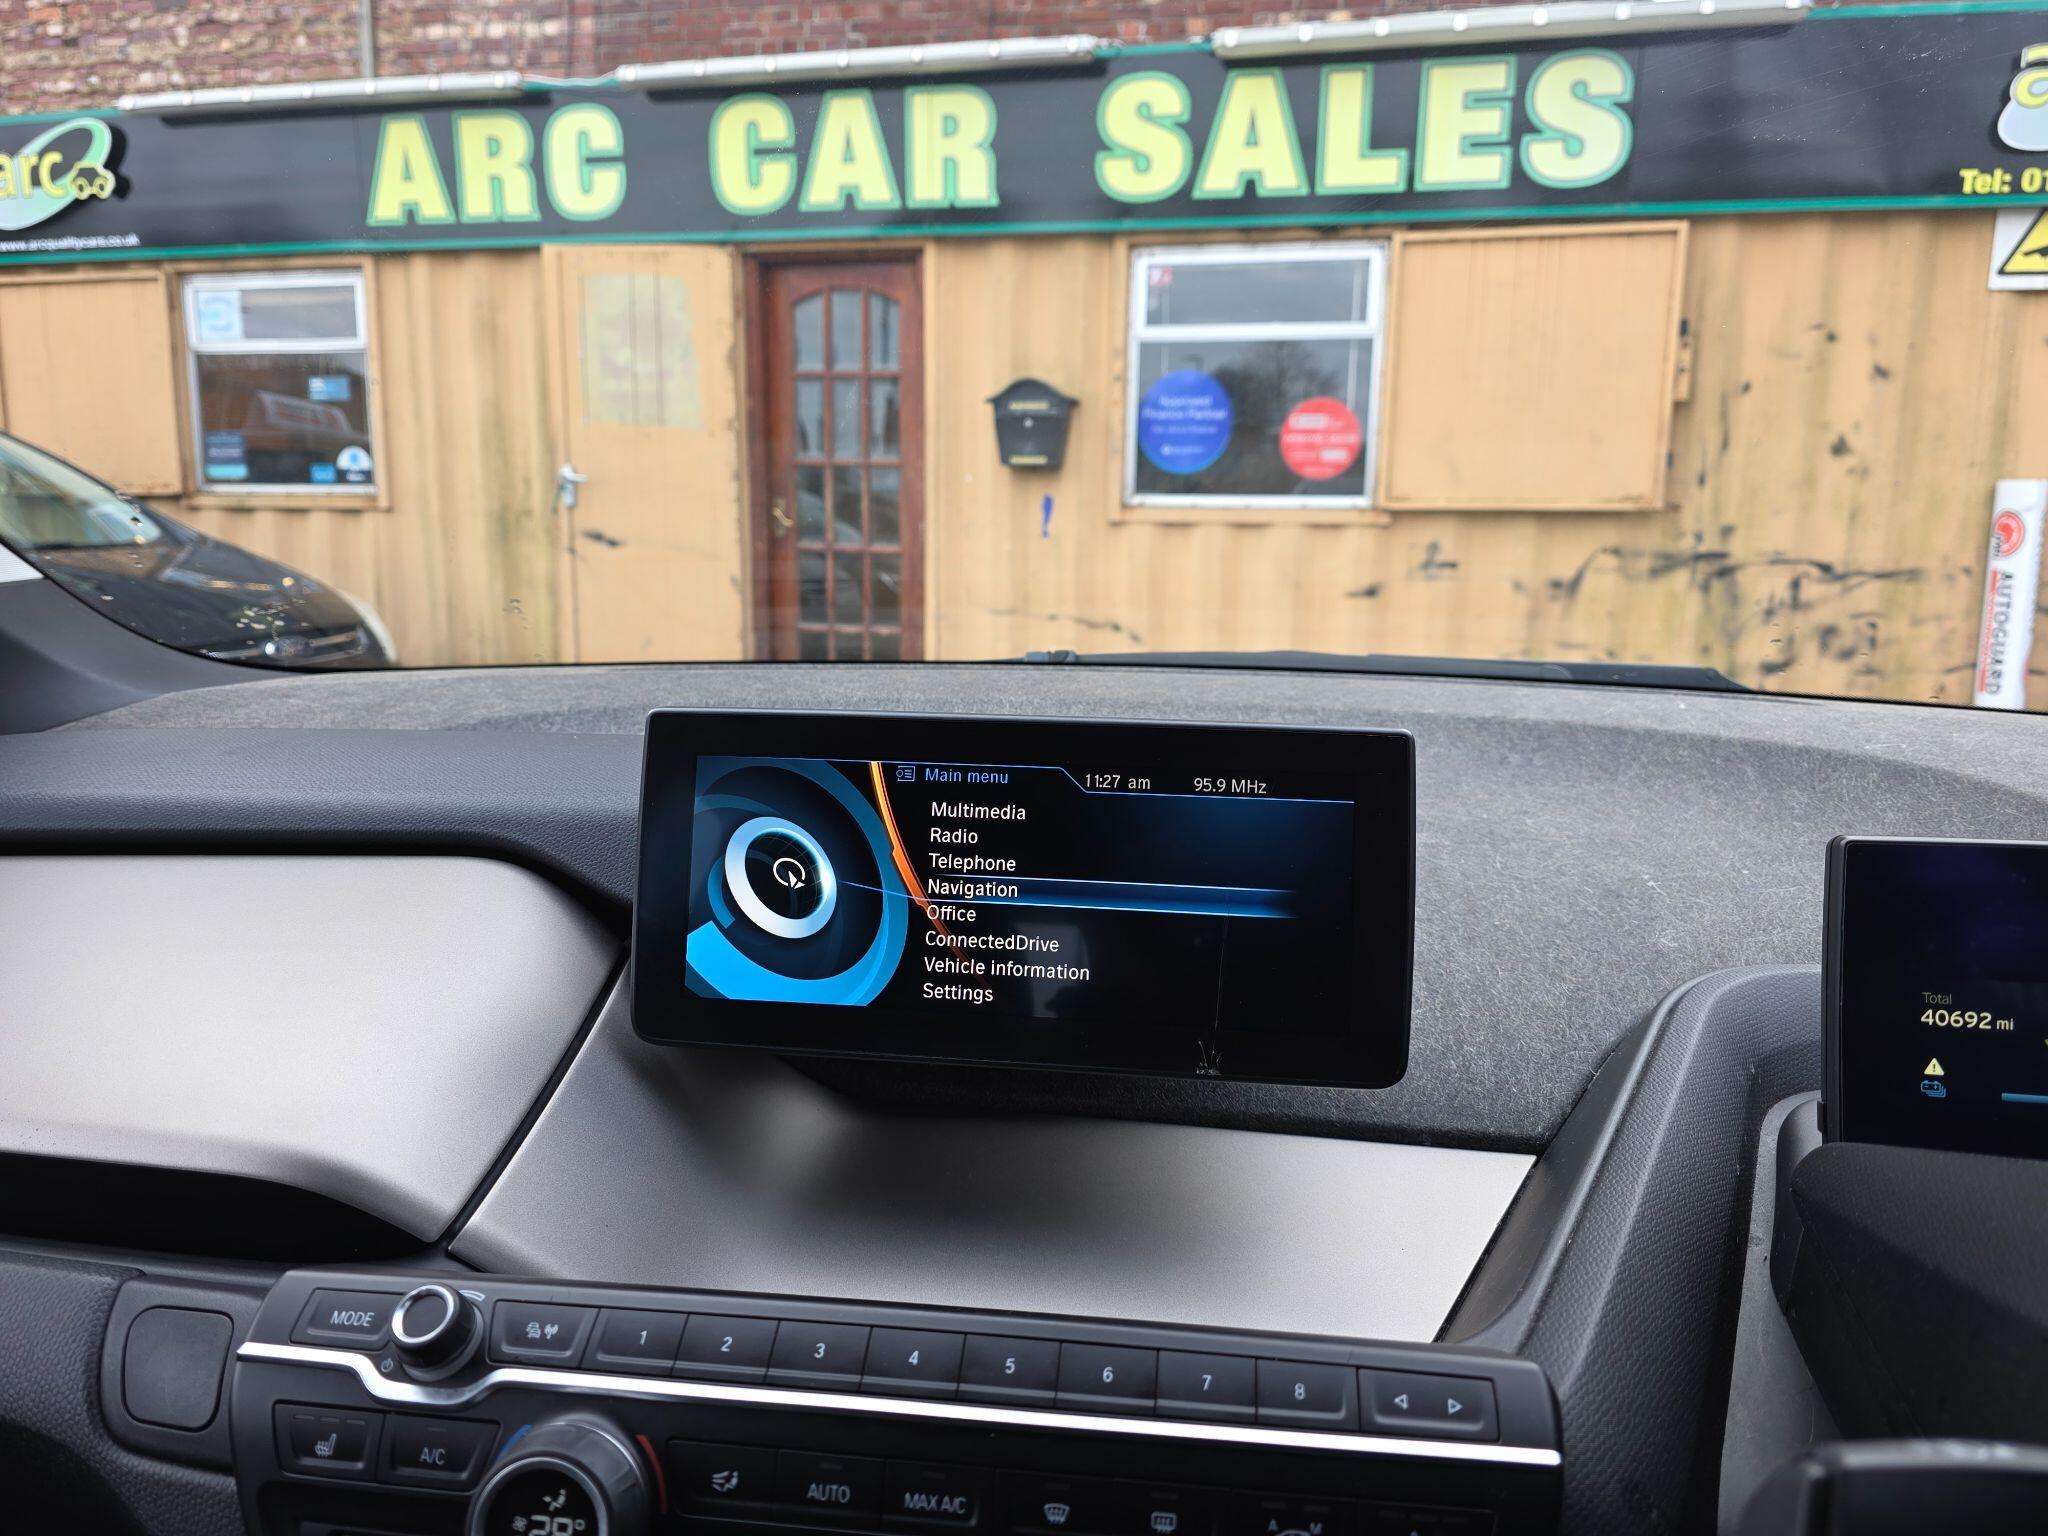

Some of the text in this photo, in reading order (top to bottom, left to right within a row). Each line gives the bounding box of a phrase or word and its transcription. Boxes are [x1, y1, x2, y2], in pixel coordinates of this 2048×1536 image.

[366, 48, 1636, 227] ARC CAR SALES
[1959, 167, 2012, 194] Tel:
[924, 767, 1009, 785] Main menu
[1084, 773, 1152, 791] 11:27 am
[1193, 777, 1267, 795] 95.9 MHz
[930, 801, 1027, 821] Multimedia
[929, 827, 979, 845] Radio
[928, 852, 1017, 873] Telephone
[927, 878, 1019, 899] Navigation
[926, 904, 977, 922] Office
[925, 930, 1060, 952] ConnectedDrive
[923, 956, 1091, 981] Vehicle information
[922, 982, 995, 1005] Settings
[1921, 991, 1952, 1005] Total
[1920, 1009, 2014, 1031] 40692 mi
[330, 1310, 376, 1328] MODE
[640, 1330, 648, 1346] 1
[720, 1336, 733, 1353] 2
[814, 1342, 826, 1359] 3
[908, 1350, 919, 1366] 4
[1005, 1357, 1016, 1374] 5
[1102, 1366, 1114, 1383] 6
[1202, 1374, 1213, 1391] 7
[1294, 1382, 1306, 1400] 8
[419, 1446, 447, 1466] A/C
[807, 1482, 851, 1503] AUTO
[904, 1492, 938, 1512] MAX
